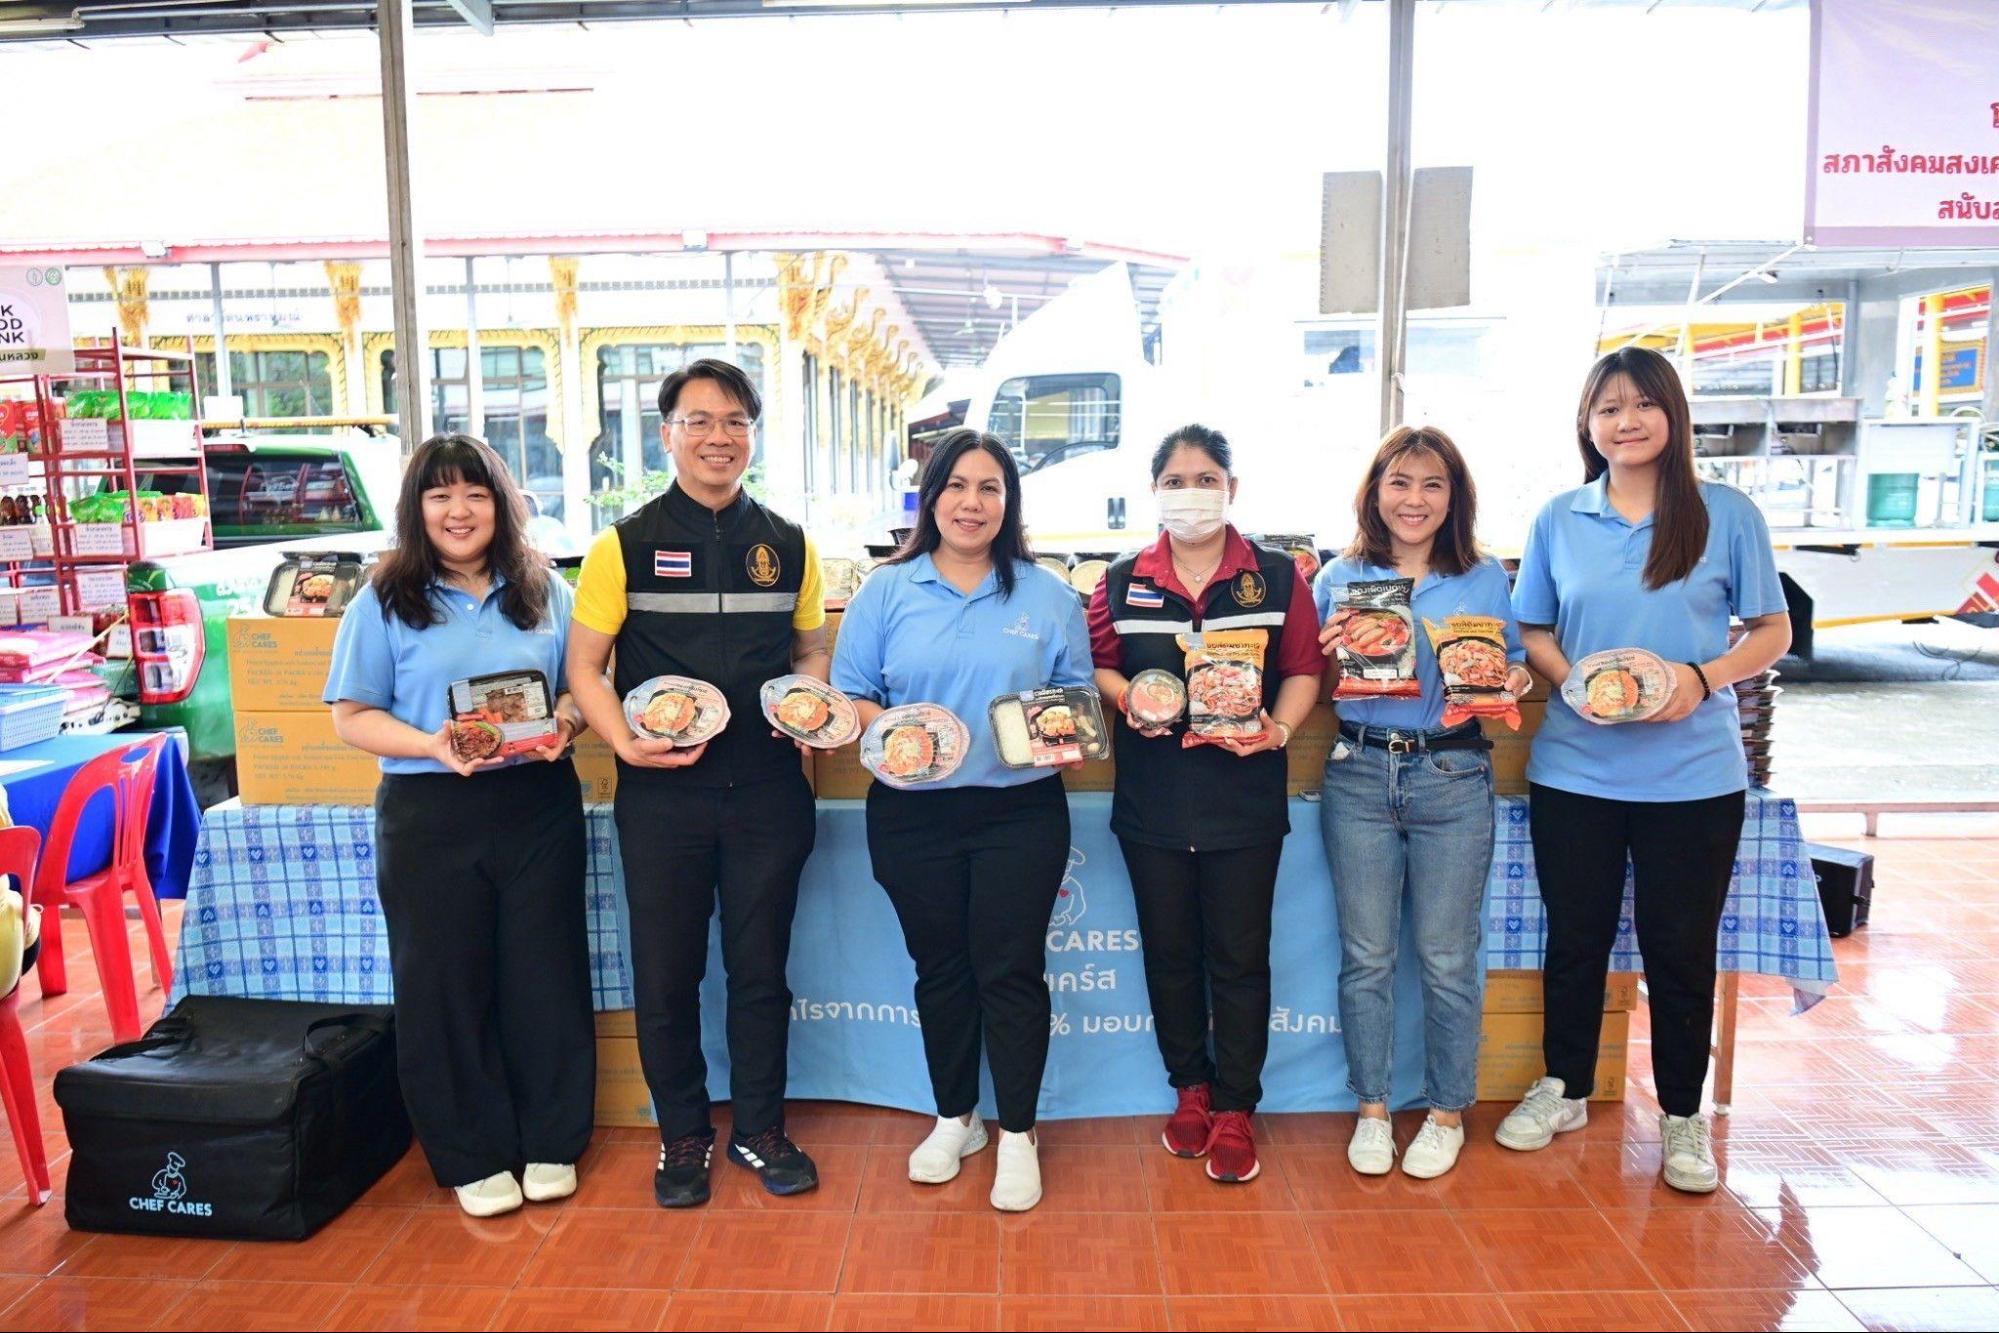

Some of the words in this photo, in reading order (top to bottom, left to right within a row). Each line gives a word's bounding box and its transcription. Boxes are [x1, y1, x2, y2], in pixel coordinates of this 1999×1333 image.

[251, 633, 272, 641] CHEF
[251, 640, 279, 649] CARES
[258, 728, 279, 736] CHEF
[258, 735, 285, 743] CARES
[1046, 929, 1140, 953] CARES
[129, 1197, 164, 1211] CHEF
[167, 1200, 213, 1216] CARES
